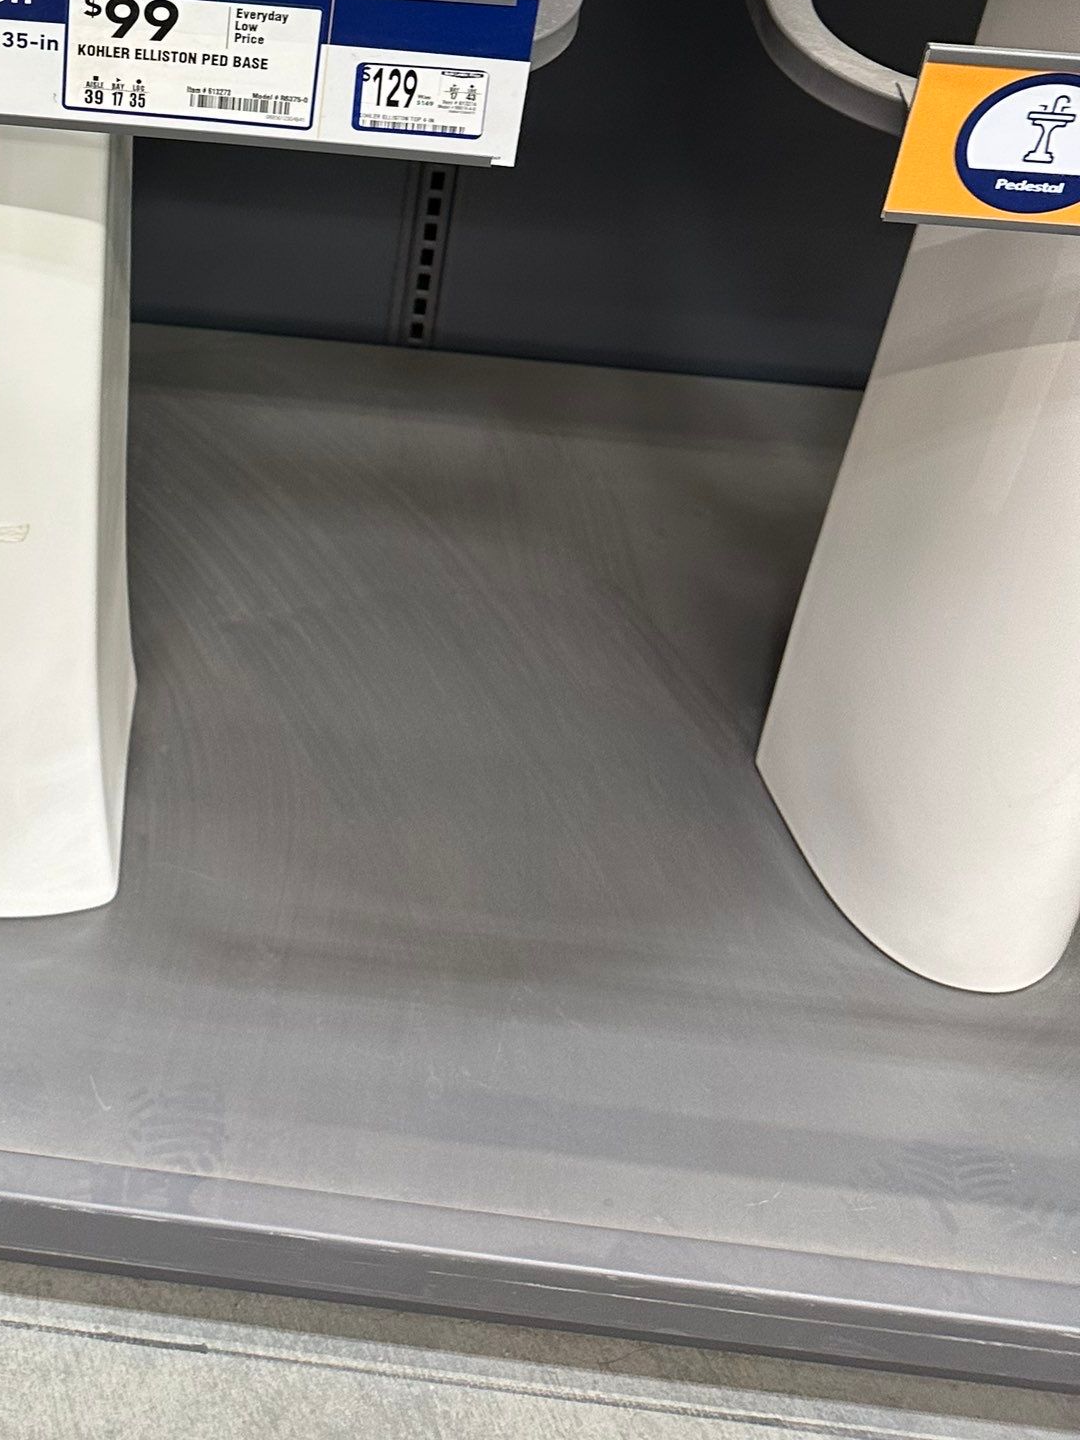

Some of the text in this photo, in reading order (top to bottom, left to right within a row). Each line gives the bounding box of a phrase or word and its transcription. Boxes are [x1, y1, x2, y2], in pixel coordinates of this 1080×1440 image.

[236, 8, 289, 24] Everyday
[234, 21, 258, 32] Low
[2, 31, 59, 51] 35-in
[234, 32, 265, 45] Price
[77, 44, 269, 70] KOHLER ELLISTON PED BASE
[84, 89, 146, 108] 39 17 35
[994, 178, 1066, 194] Pedestal
